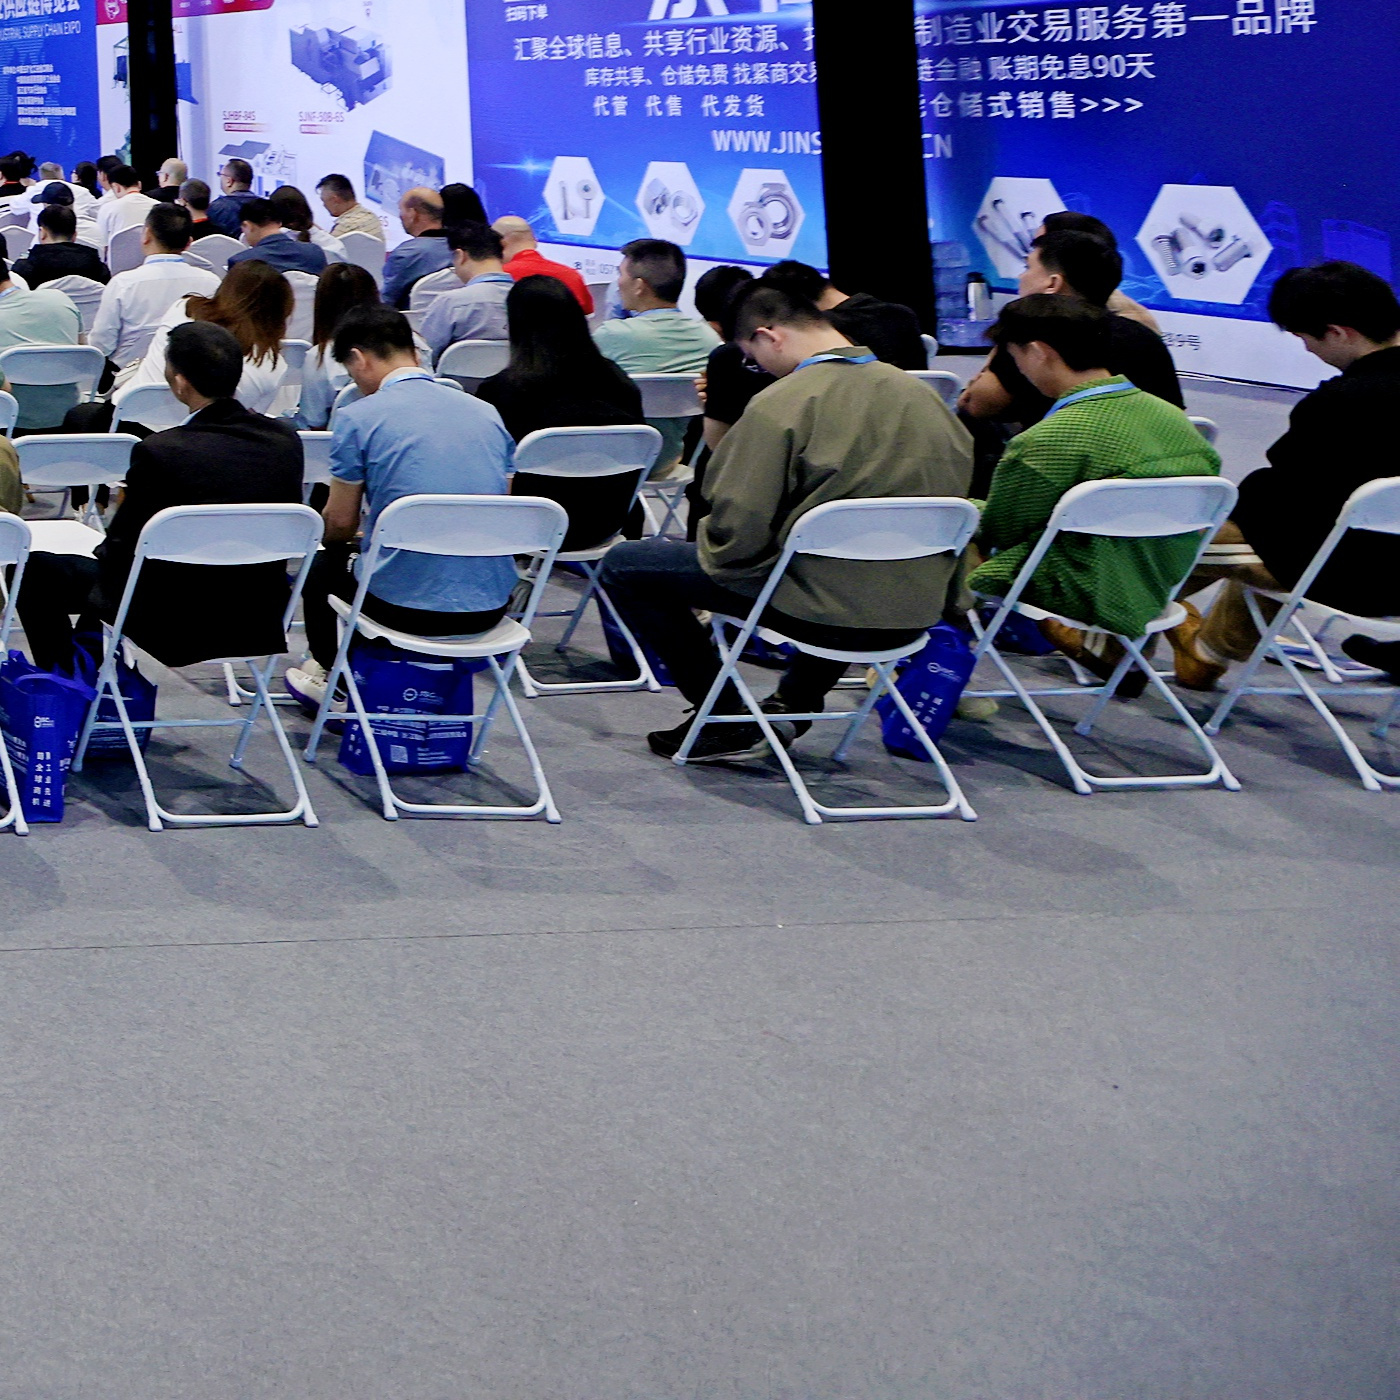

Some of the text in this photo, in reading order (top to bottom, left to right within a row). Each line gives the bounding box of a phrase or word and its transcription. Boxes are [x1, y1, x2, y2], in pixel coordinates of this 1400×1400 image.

[505, 4, 548, 22] 扫码下单
[585, 63, 729, 88] 库存共享、仓储免费
[987, 52, 1156, 81] 账期免息90天
[594, 94, 628, 117] 代管
[645, 94, 683, 117] 代售
[701, 93, 765, 118] 代发货
